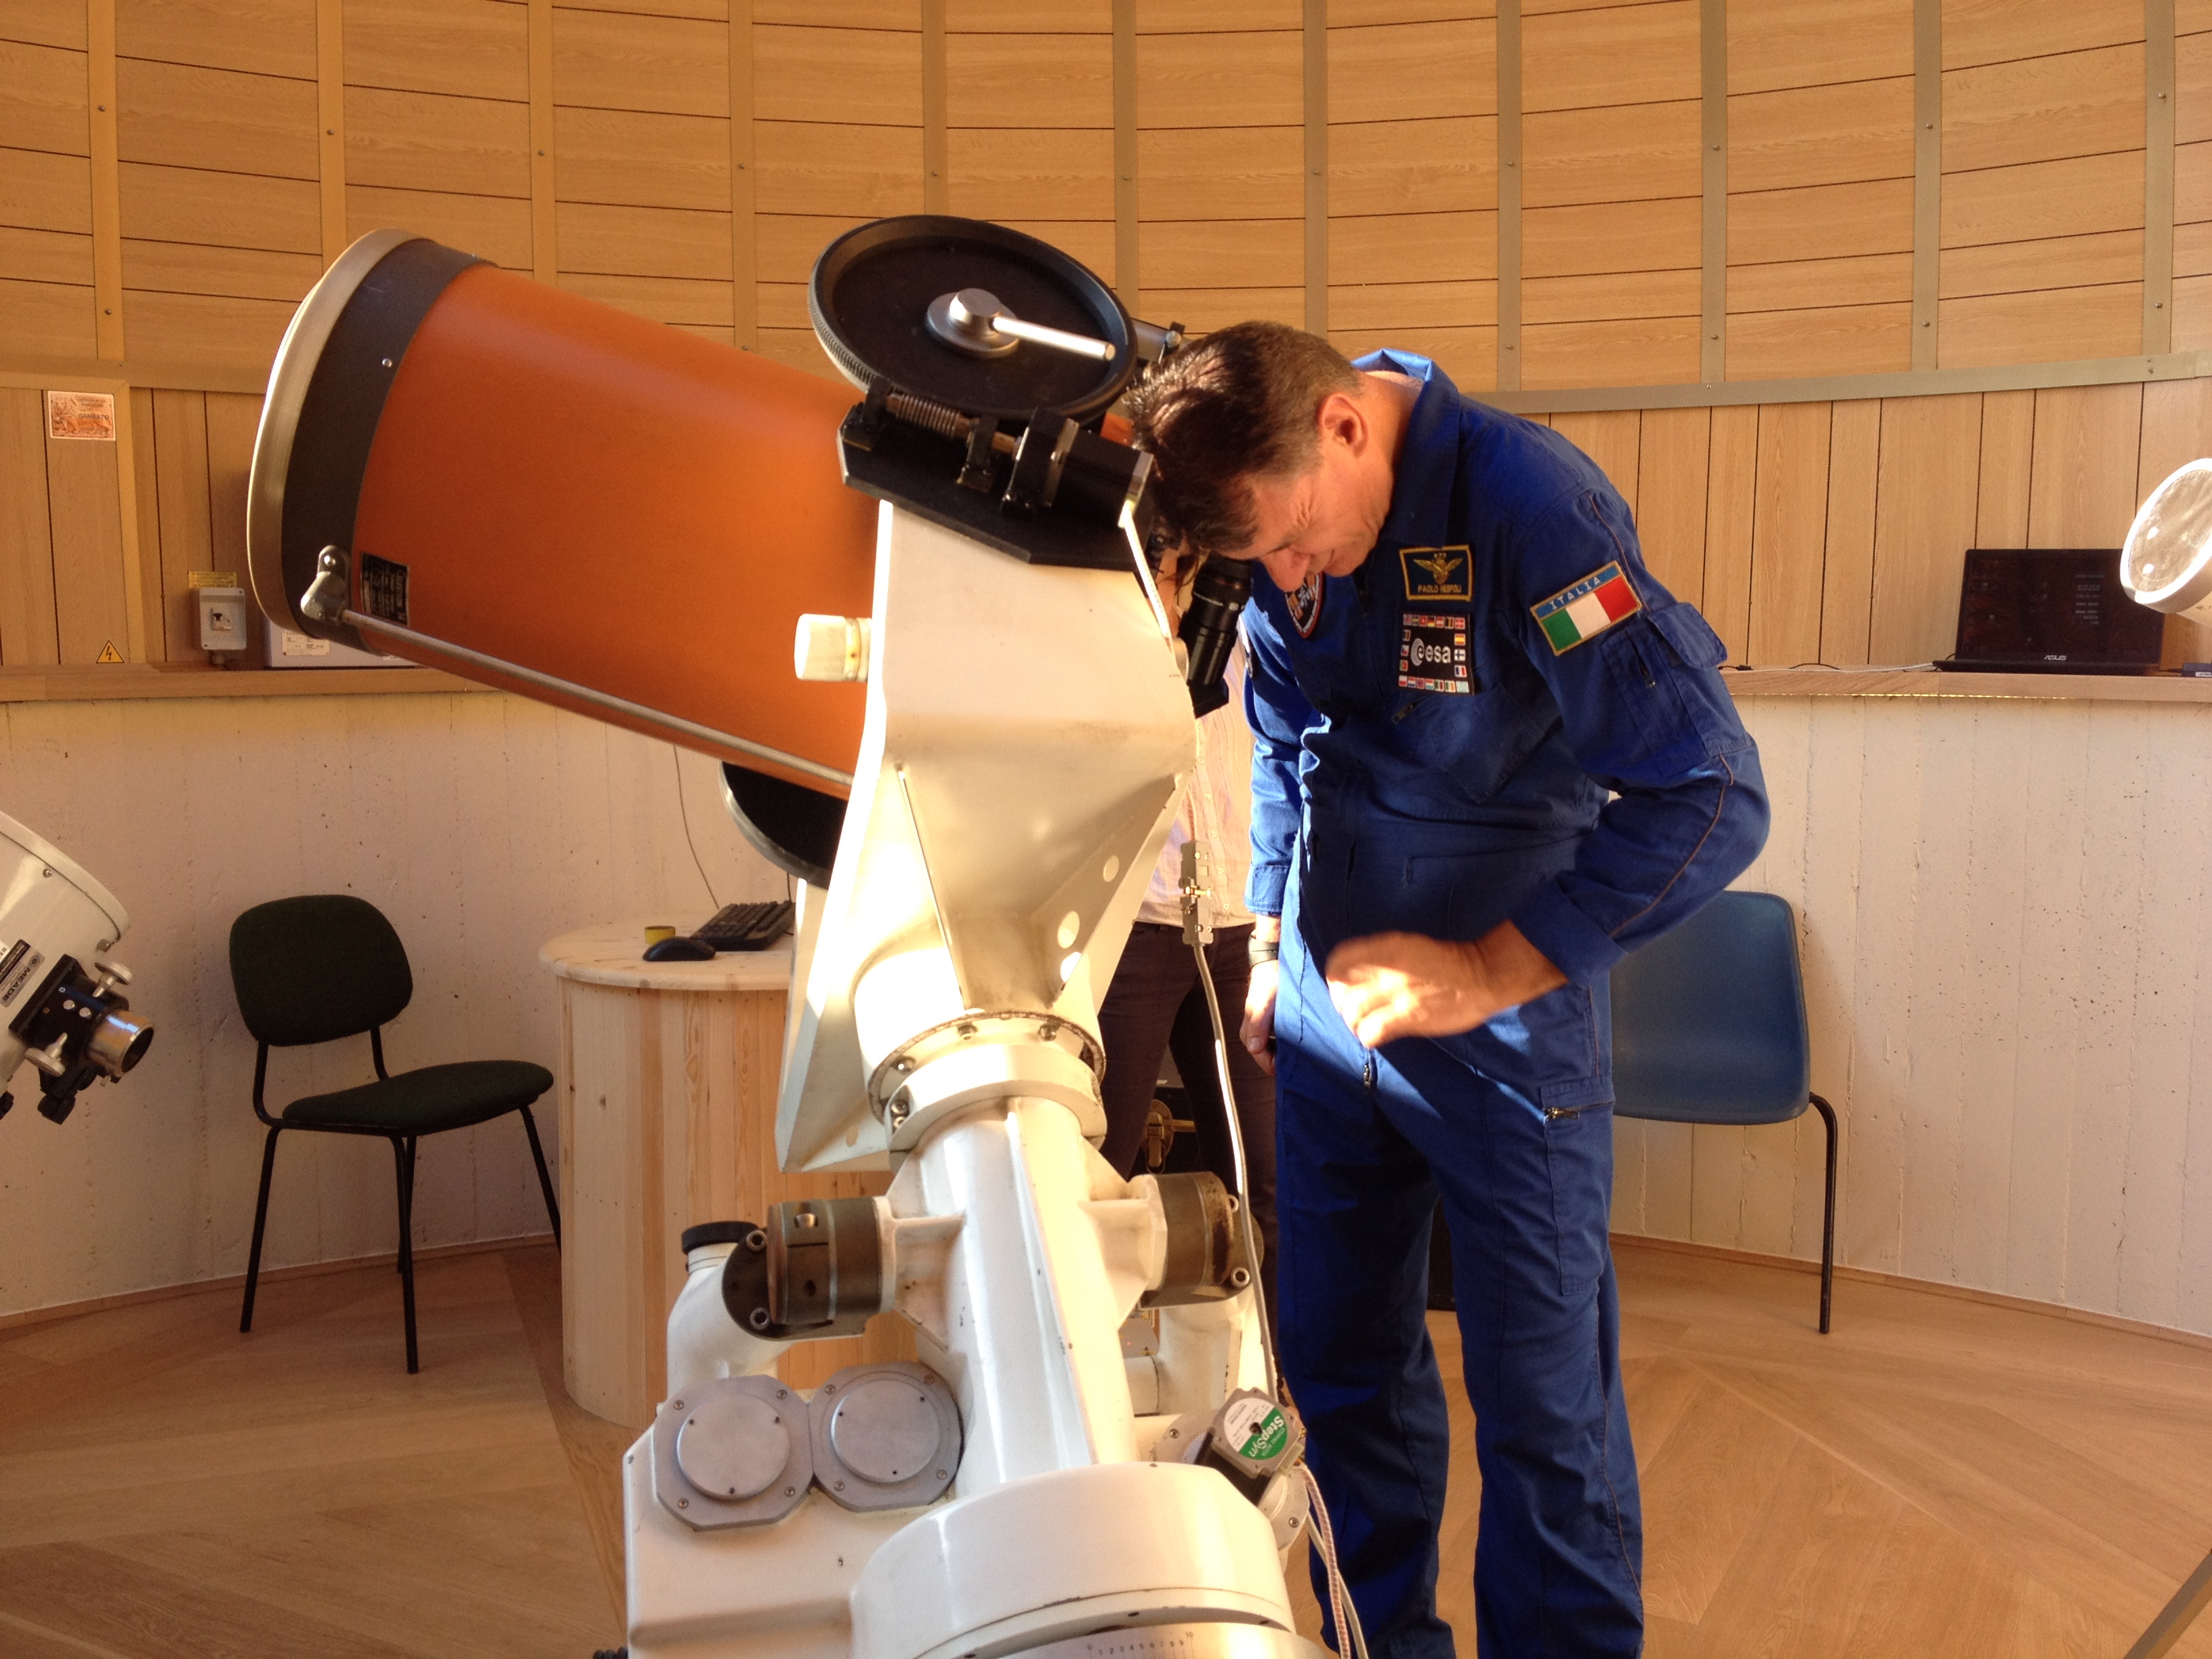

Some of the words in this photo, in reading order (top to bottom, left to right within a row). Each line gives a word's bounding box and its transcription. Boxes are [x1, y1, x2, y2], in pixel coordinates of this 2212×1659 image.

[1549, 577, 1600, 610] ITALIA
[3, 968, 30, 1001] MEADE
[1248, 1416, 1284, 1457] StepSyn
